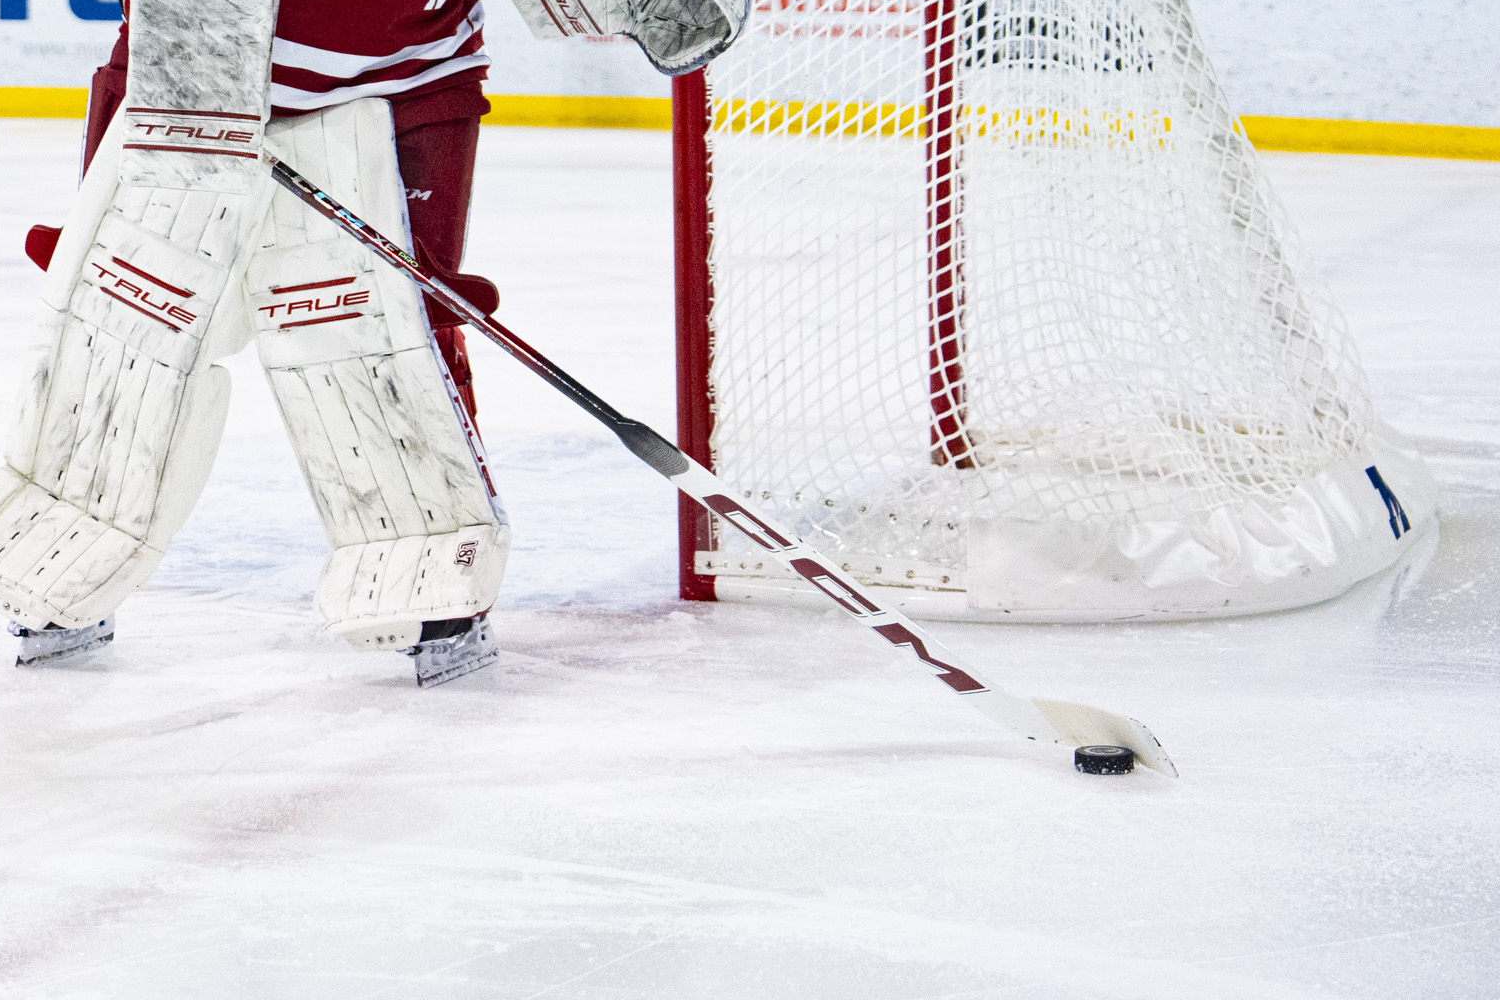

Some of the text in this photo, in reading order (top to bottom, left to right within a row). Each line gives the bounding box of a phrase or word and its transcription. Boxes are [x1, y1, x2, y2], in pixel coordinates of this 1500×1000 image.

[135, 124, 254, 143] TRUE
[397, 251, 419, 268] PRO
[91, 262, 197, 325] TRUE
[258, 290, 370, 318] TRUE
[455, 539, 479, 567] L87
[702, 493, 991, 694] CCM
